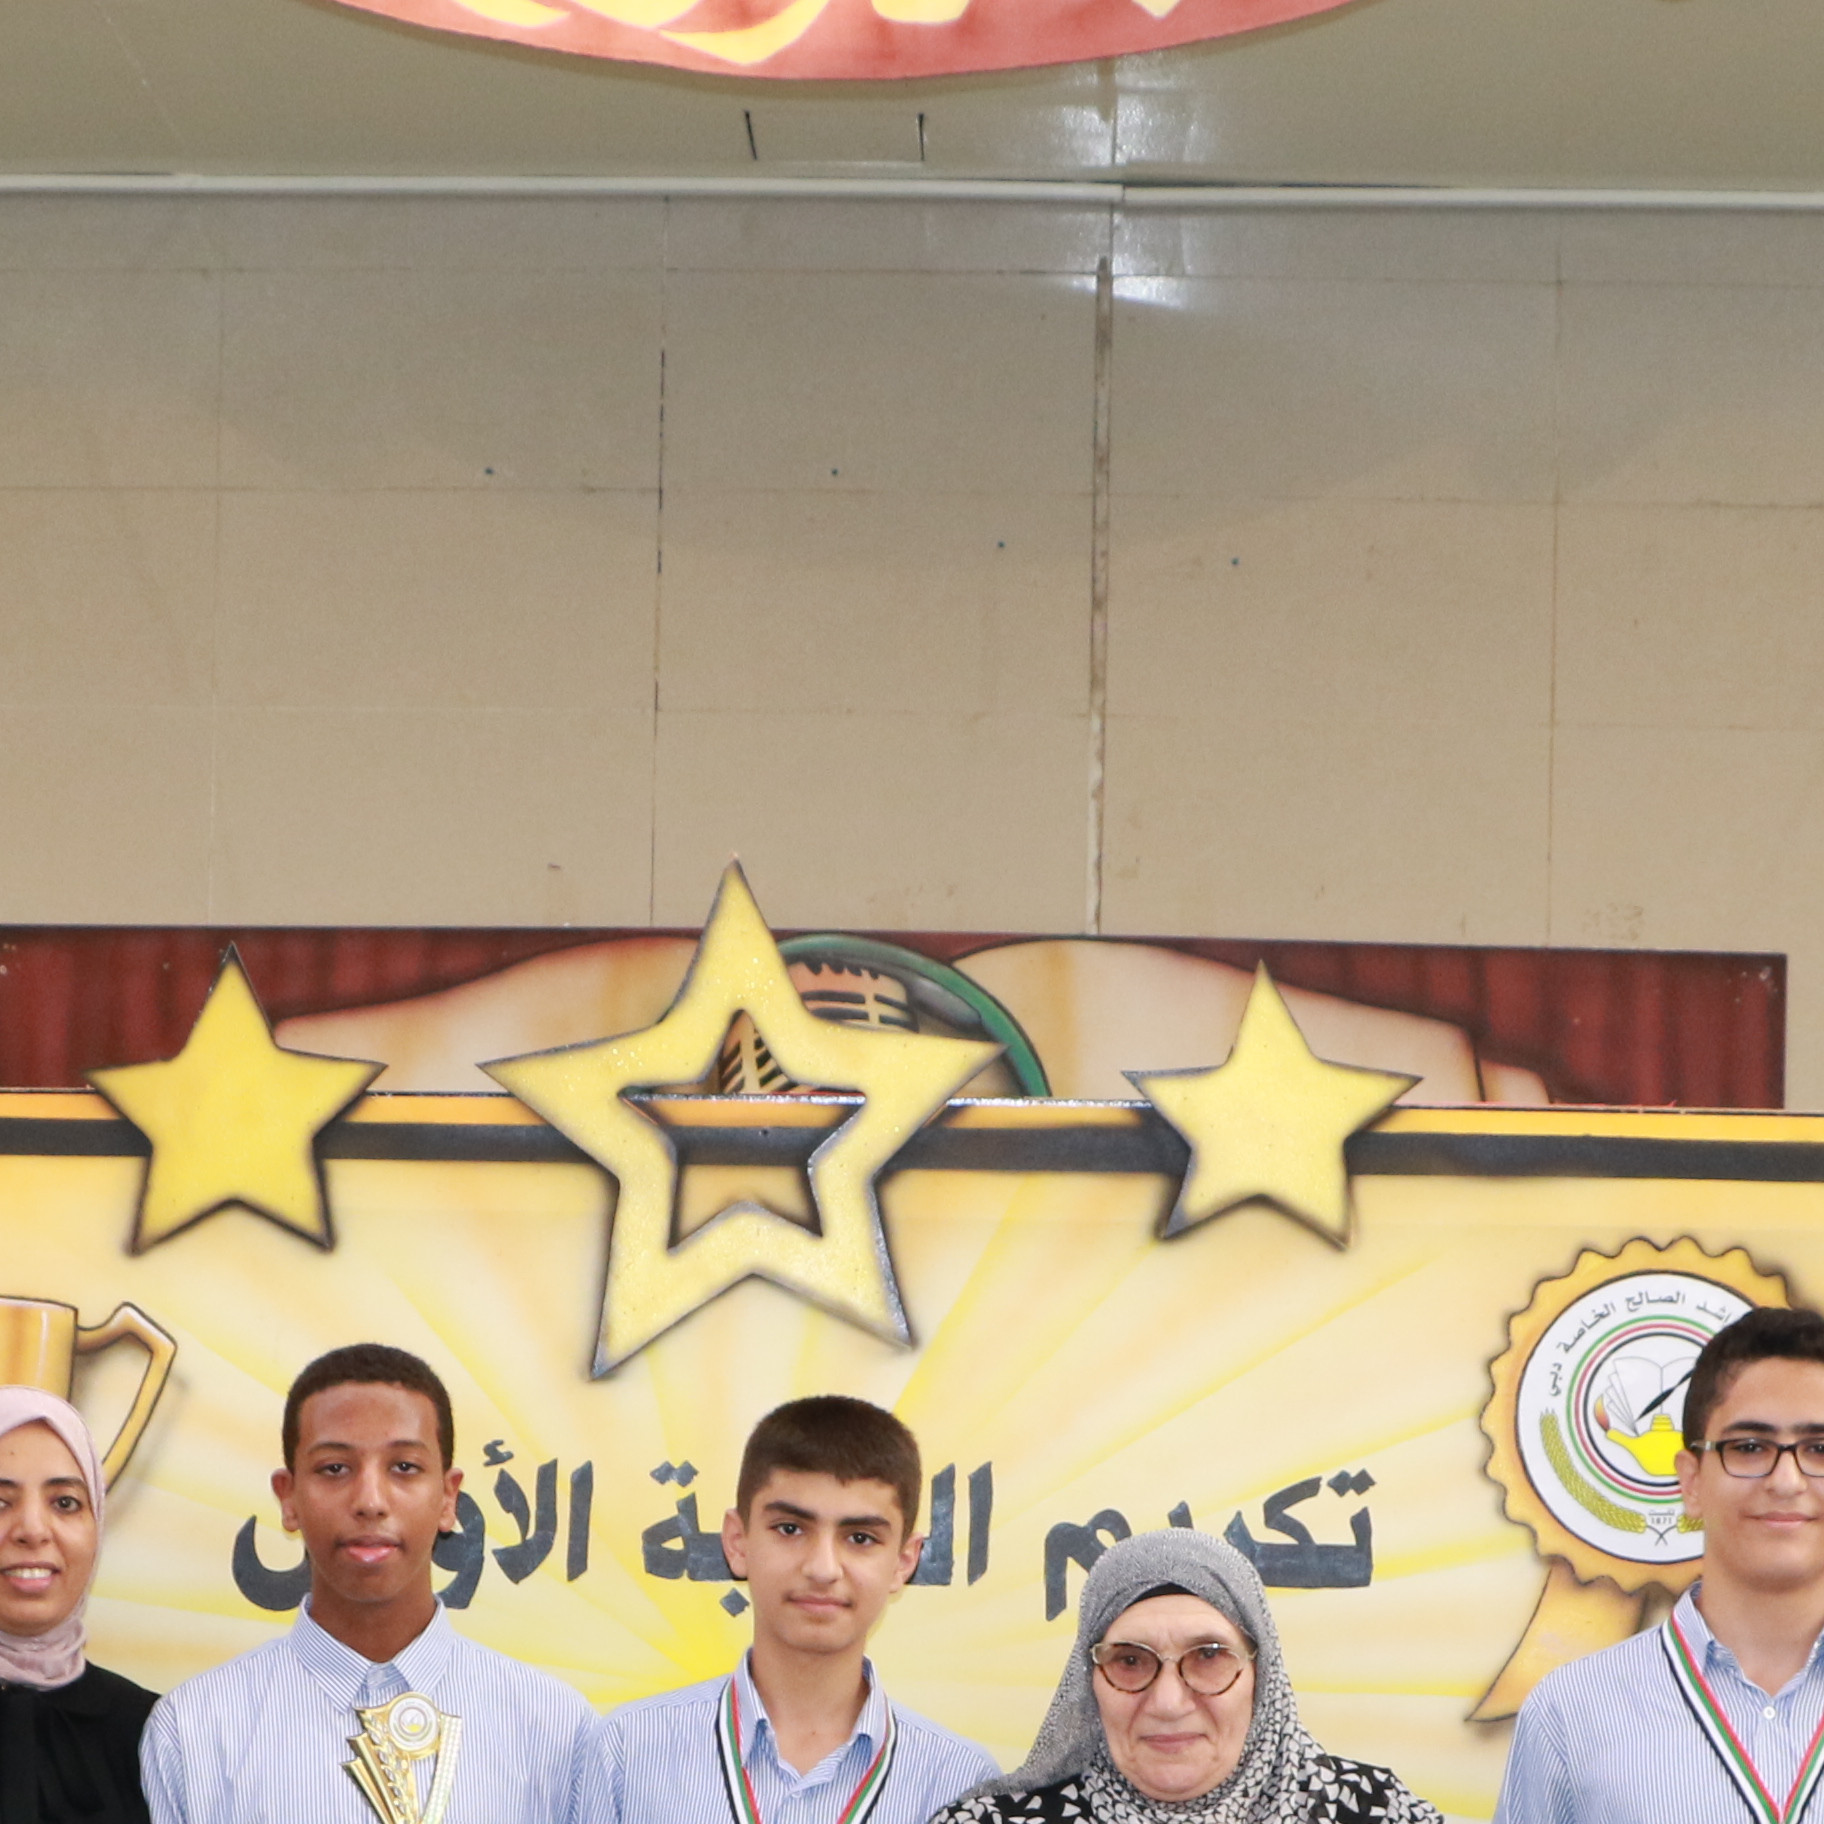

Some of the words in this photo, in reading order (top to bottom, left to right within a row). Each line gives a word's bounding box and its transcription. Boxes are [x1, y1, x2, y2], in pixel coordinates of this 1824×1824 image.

[1625, 1290, 1686, 1313] الصالح
[1696, 1300, 1733, 1324] اشد
[1555, 1301, 1617, 1353] الخاصة
[1549, 1361, 1563, 1397] دبي
